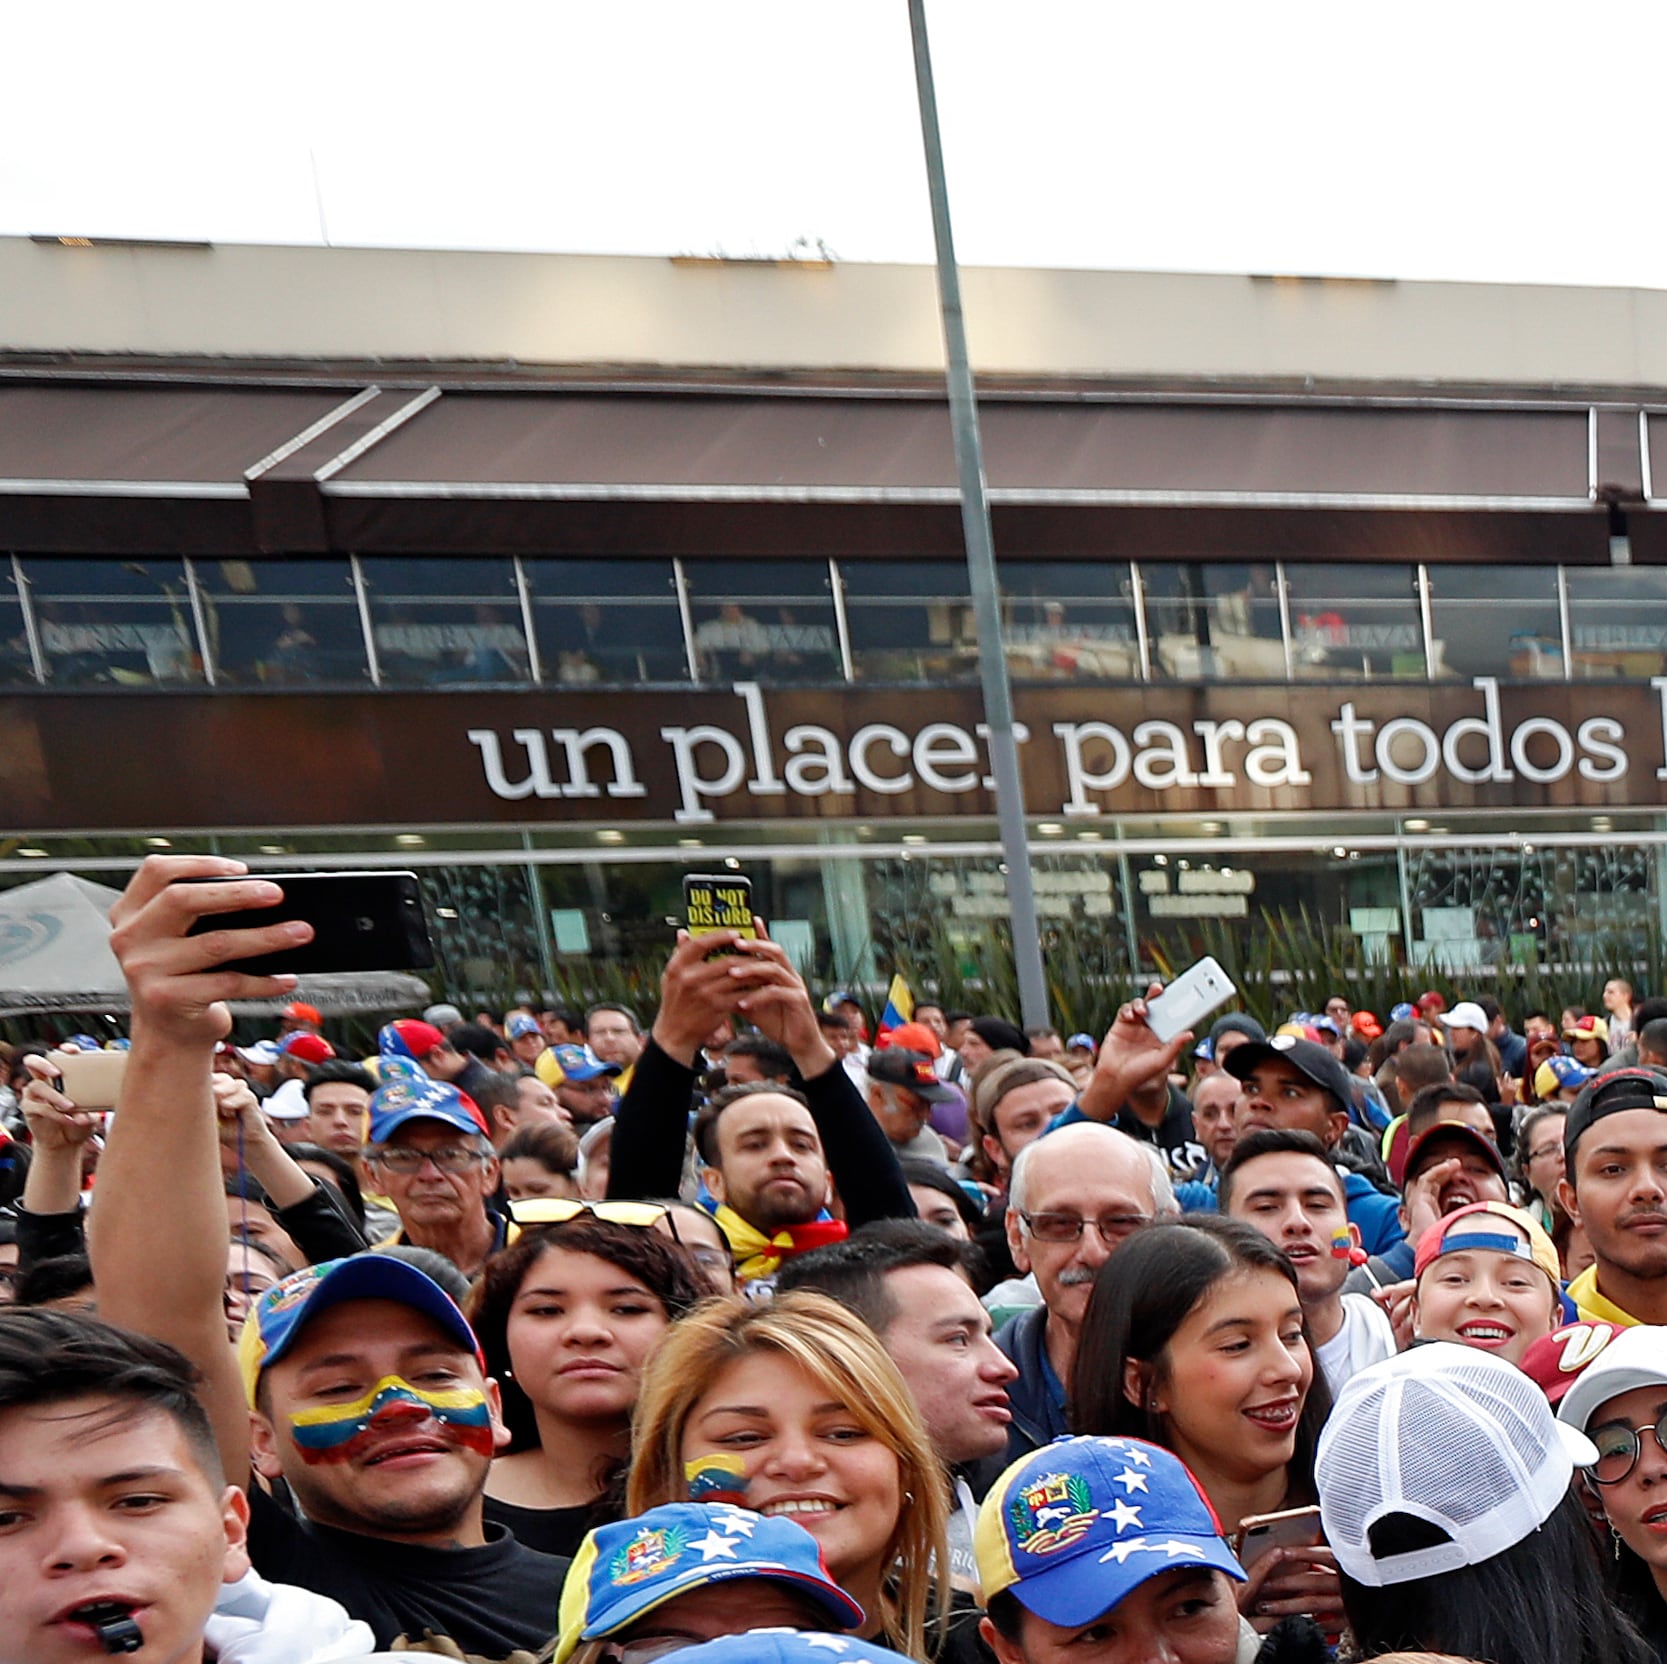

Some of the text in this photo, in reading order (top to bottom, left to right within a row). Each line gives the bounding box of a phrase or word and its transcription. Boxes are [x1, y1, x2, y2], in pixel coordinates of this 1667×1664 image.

[468, 728, 646, 800] un
[661, 681, 1029, 824] placer
[1053, 719, 1311, 816] para
[1331, 676, 1629, 785] todos
[689, 888, 747, 907] DO NOT
[687, 905, 752, 926] DISTURB
